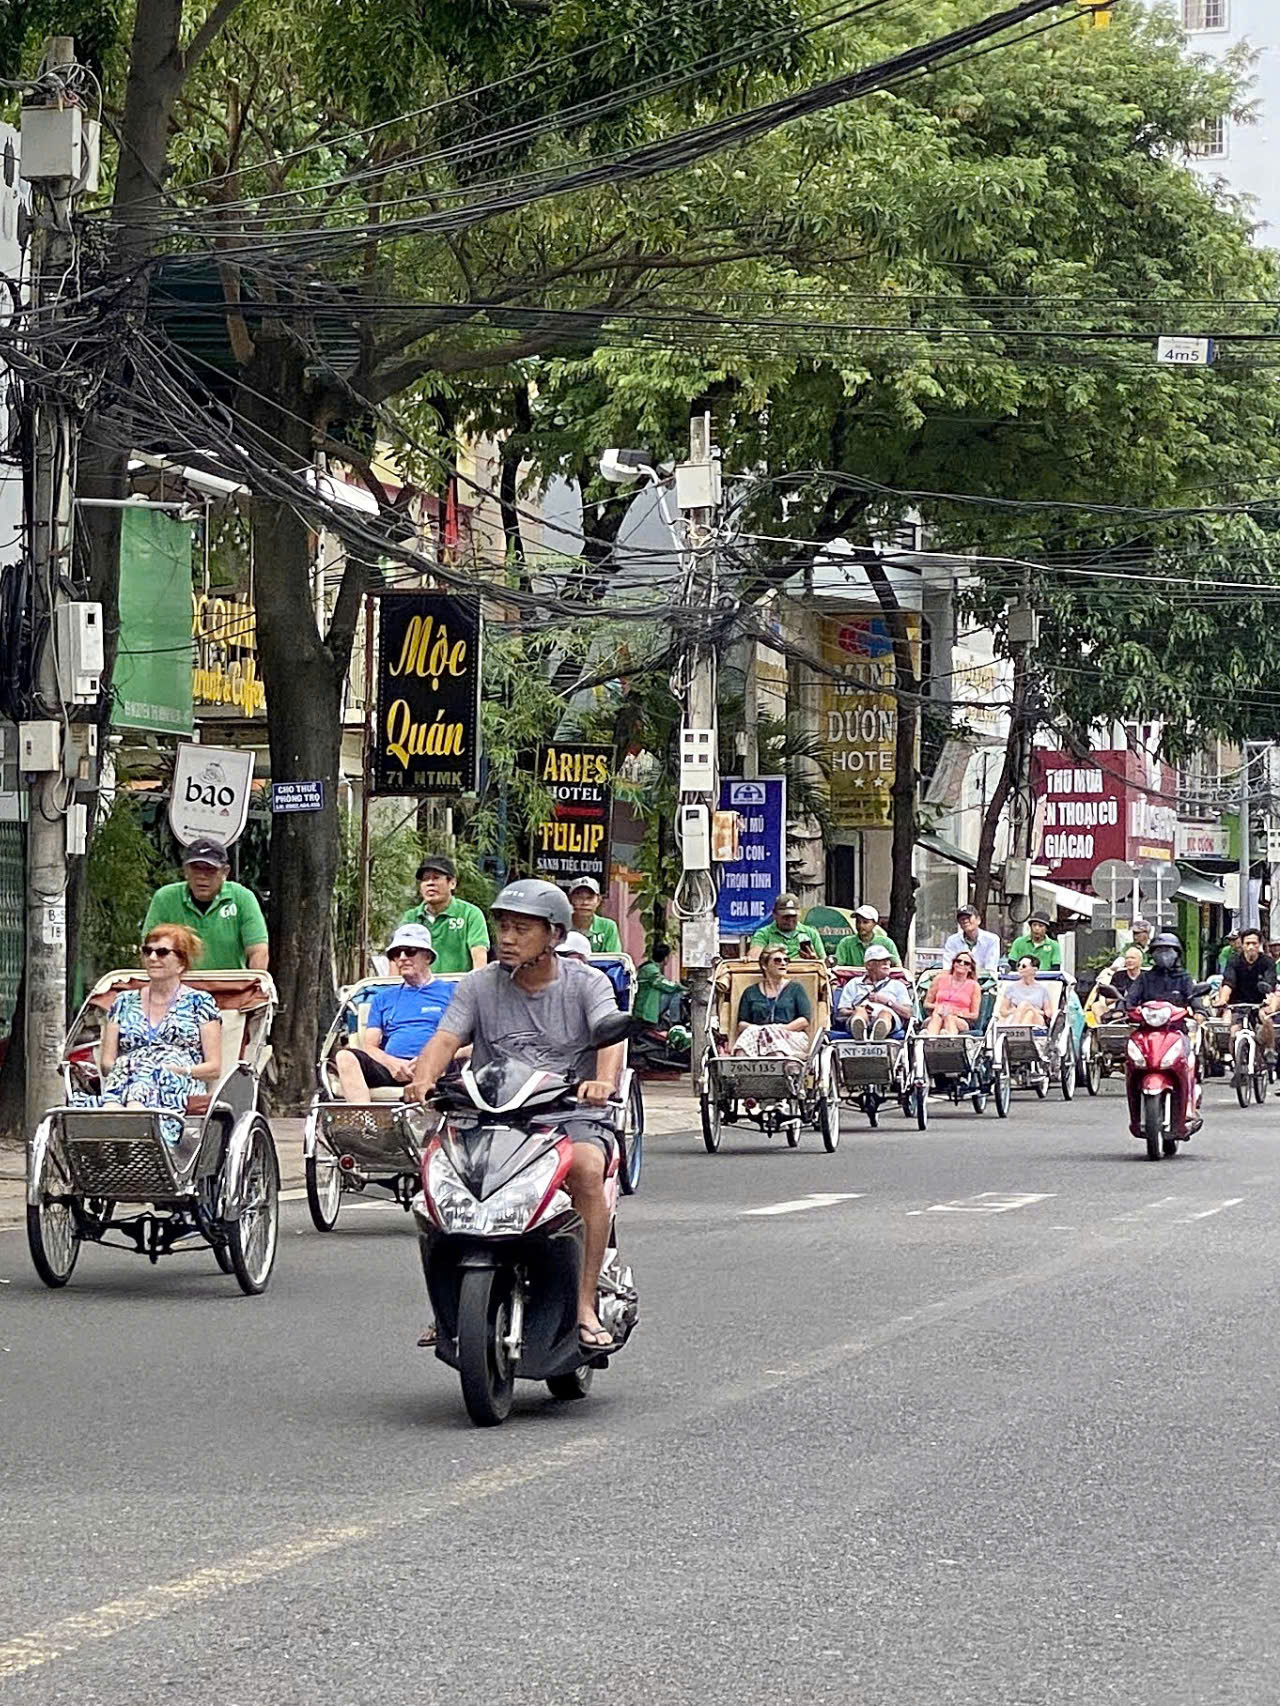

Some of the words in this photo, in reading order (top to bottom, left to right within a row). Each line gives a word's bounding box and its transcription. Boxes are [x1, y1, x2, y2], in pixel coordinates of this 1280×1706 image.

[1165, 349, 1200, 361] 4m5
[388, 614, 467, 691] Mộc
[385, 698, 466, 770] Quán
[827, 703, 894, 742] DƯƠN
[542, 747, 608, 784] ARIES
[832, 751, 893, 771] HOTE
[387, 770, 404, 785] 71
[1046, 768, 1073, 793] THU
[1073, 768, 1103, 793] MUA
[184, 775, 235, 807] bao
[537, 821, 605, 853] TULIP
[220, 903, 238, 918] 60
[730, 901, 748, 917] CHA
[448, 917, 465, 930] 59
